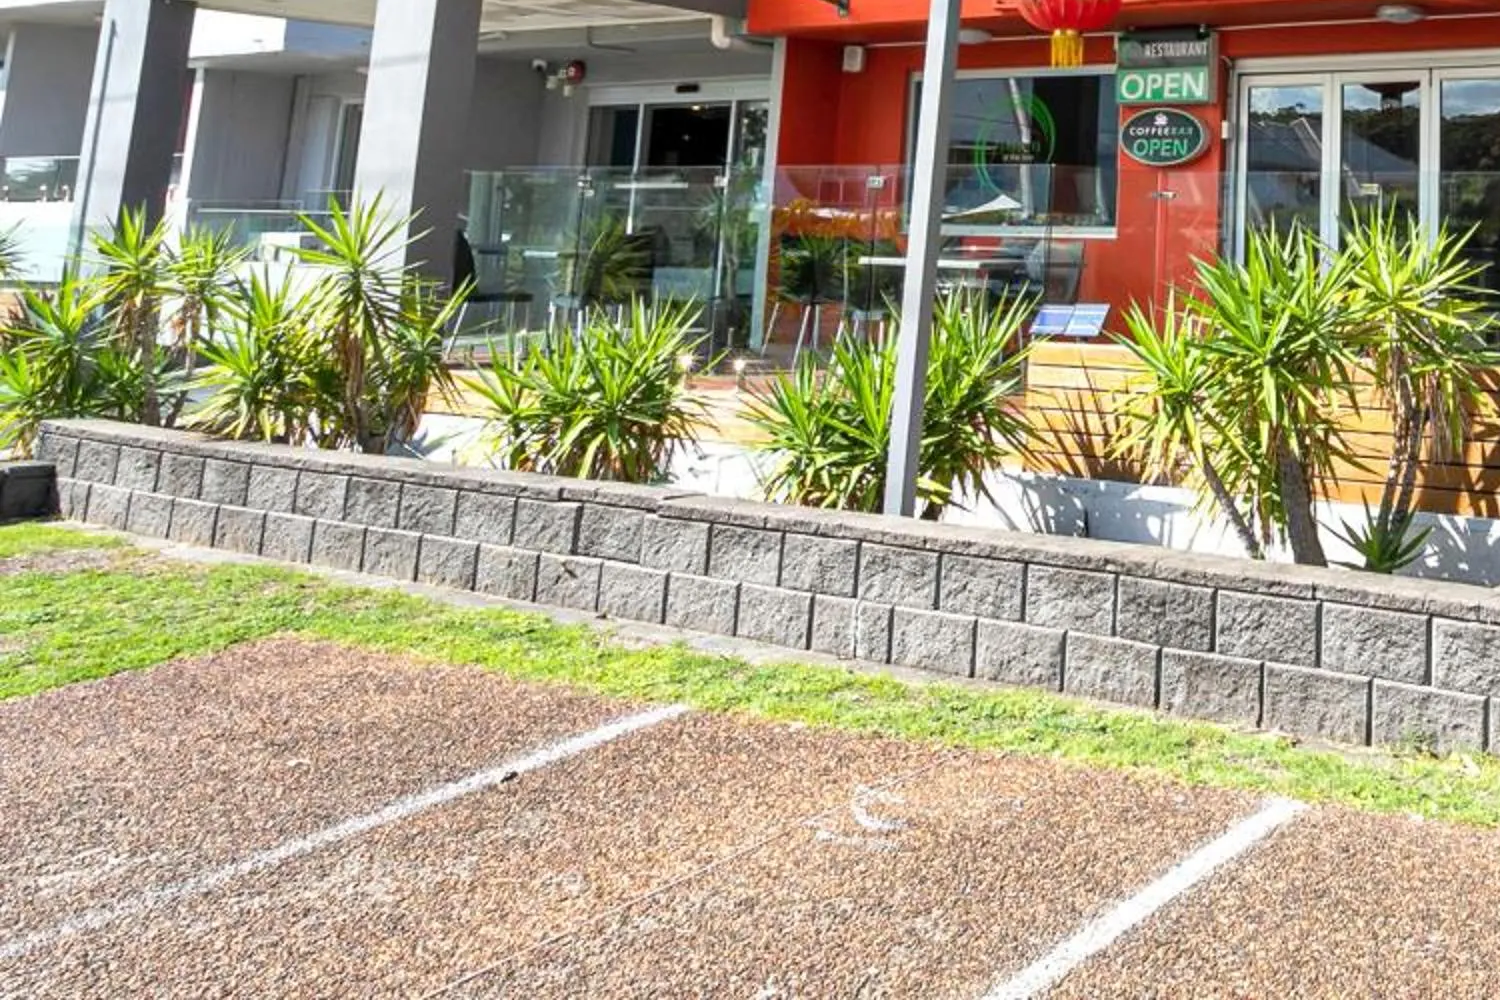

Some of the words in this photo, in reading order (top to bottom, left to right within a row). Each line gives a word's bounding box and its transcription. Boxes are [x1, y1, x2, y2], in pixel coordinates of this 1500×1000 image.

[1143, 41, 1207, 57] RESTAURANT
[1120, 72, 1204, 99] OPEN
[1133, 139, 1187, 156] OPEN
